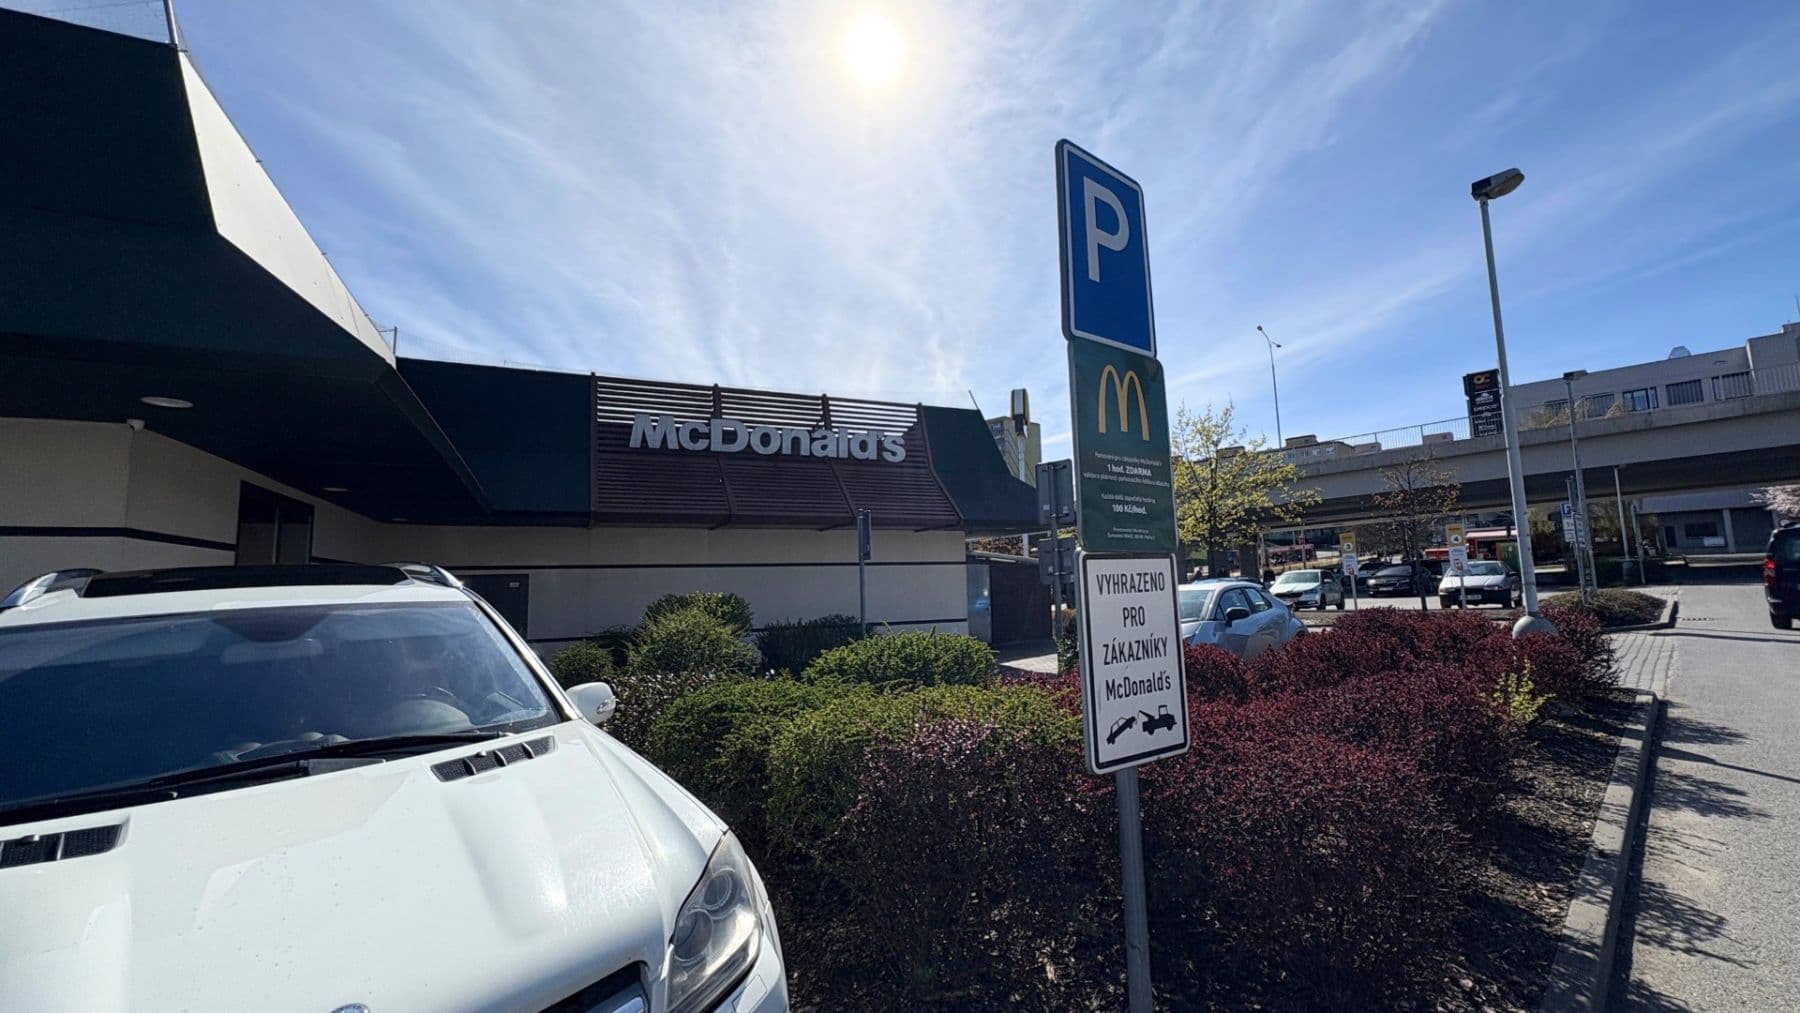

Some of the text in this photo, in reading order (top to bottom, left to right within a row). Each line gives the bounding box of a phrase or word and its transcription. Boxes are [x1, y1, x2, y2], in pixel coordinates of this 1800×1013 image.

[1083, 175, 1130, 283] P
[629, 413, 907, 463] McDonald's
[1125, 465, 1152, 477] ZDARMA
[1112, 504, 1123, 513] 100
[1096, 571, 1165, 596] VYHRAZENO
[1122, 605, 1146, 628] PRO
[1102, 633, 1168, 666] ZÁKAZNÍKY
[1105, 670, 1171, 701] McDonald's
